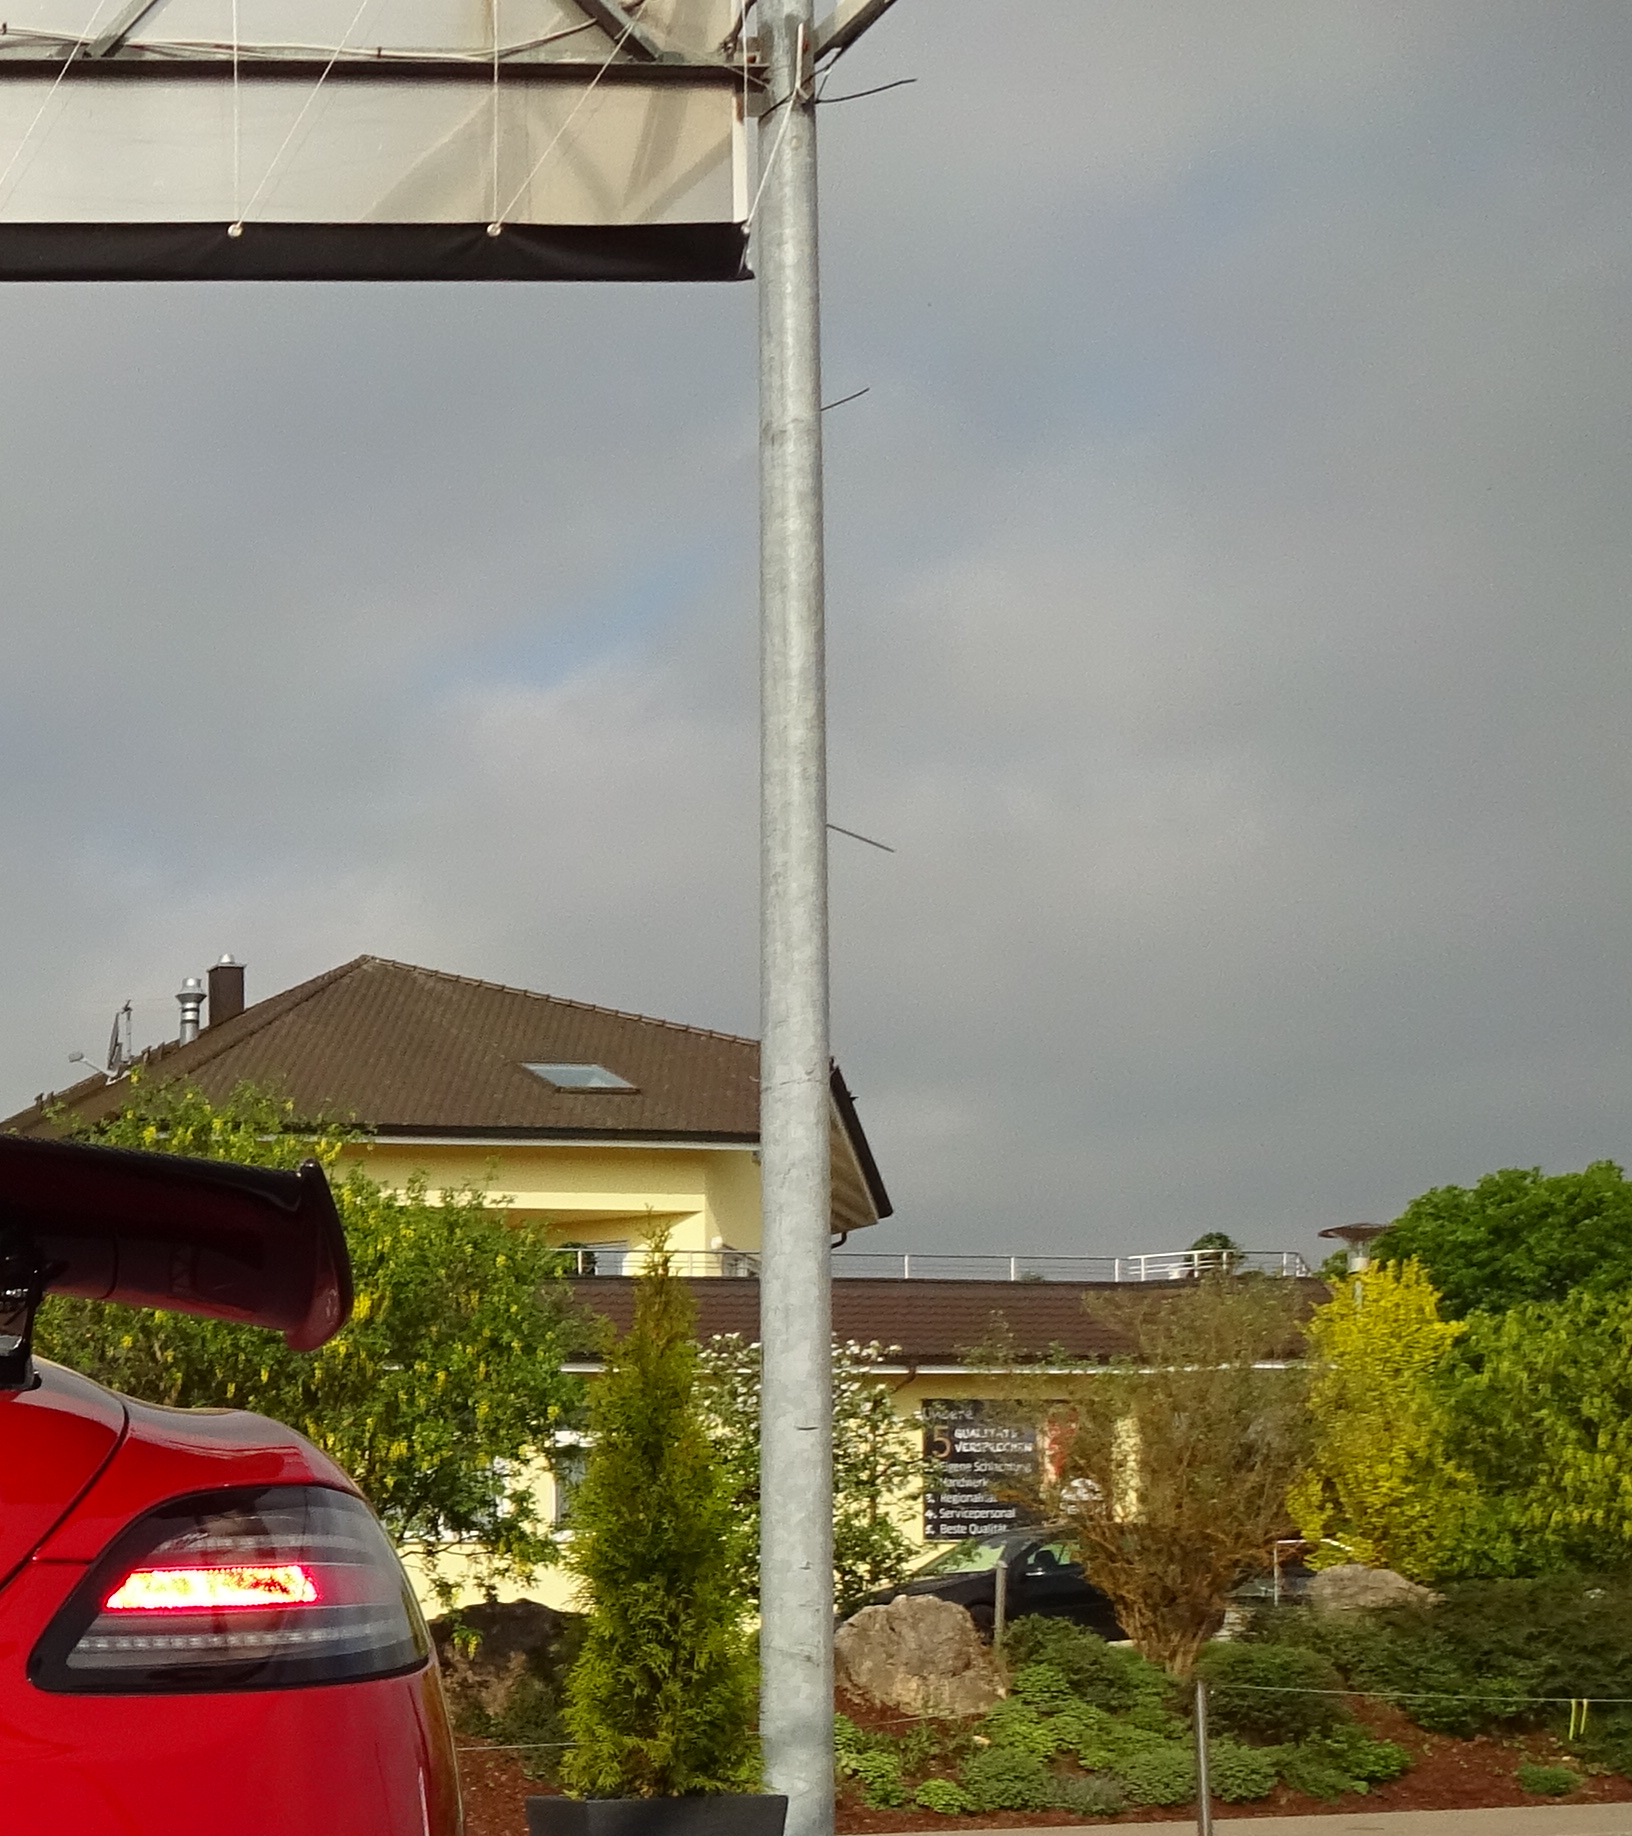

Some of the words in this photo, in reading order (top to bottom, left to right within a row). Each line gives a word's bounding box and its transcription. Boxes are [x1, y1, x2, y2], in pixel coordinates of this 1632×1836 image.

[932, 1425, 952, 1458] 5
[939, 1508, 1016, 1519] Servicepersonal
[940, 1523, 967, 1534] Beste
